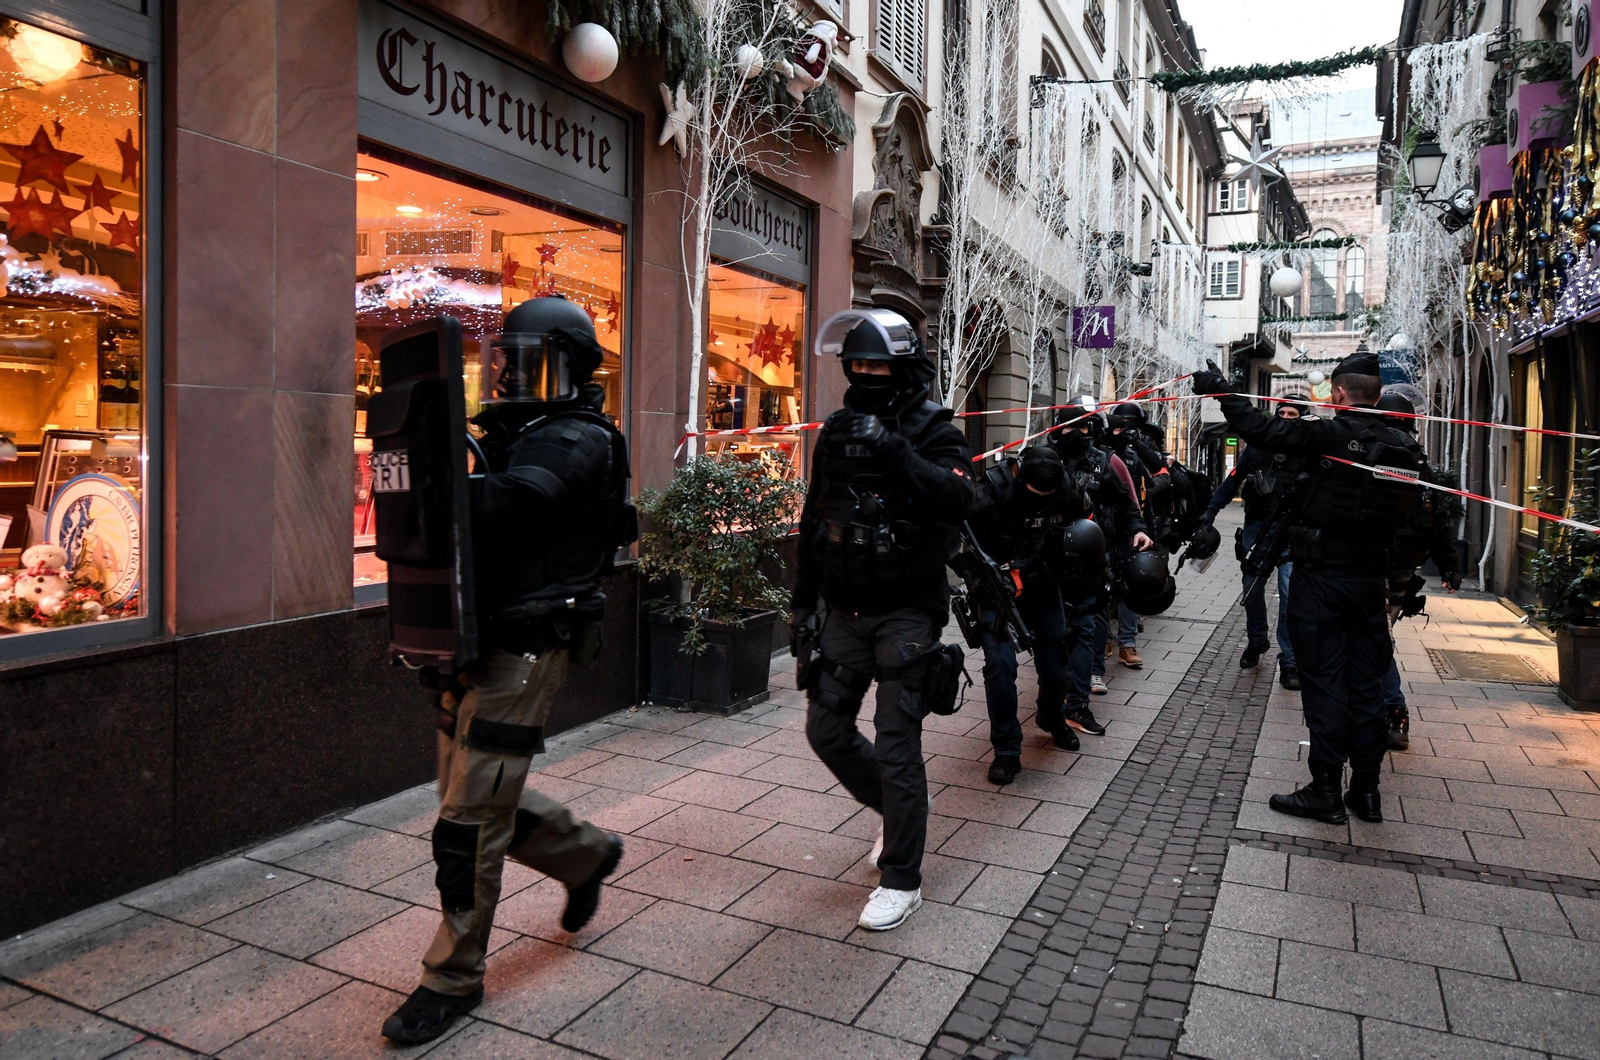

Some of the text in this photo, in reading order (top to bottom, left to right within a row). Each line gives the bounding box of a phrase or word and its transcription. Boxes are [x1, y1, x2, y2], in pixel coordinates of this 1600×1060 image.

[376, 26, 612, 174] Charcuterie
[712, 180, 803, 252] Boucherie
[372, 452, 409, 468] OLICE
[108, 490, 135, 525] CAVIAR
